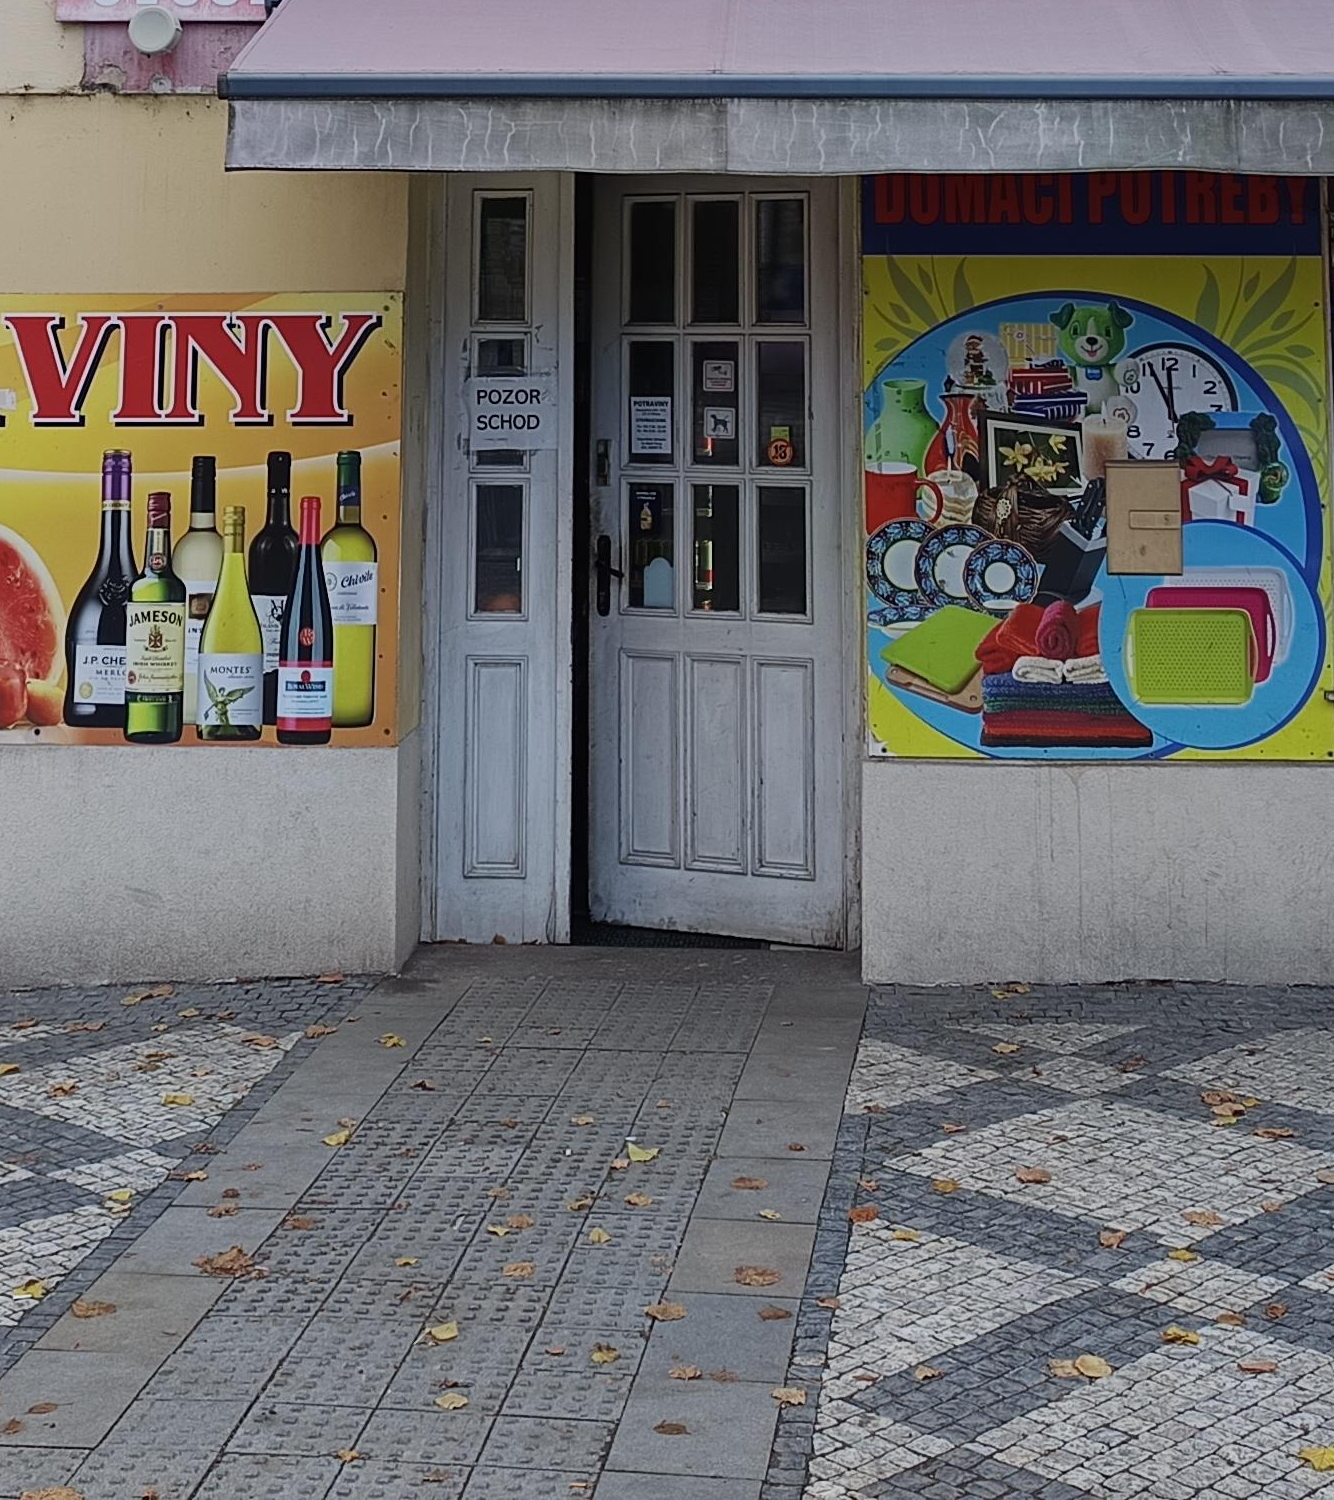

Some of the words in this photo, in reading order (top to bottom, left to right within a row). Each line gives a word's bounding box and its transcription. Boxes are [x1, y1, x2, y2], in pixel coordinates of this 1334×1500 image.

[1161, 357, 1179, 372] 12
[1203, 381, 1217, 395] 2
[476, 389, 542, 407] POZOR
[476, 414, 541, 432] SCHOD
[1127, 425, 1141, 438] 8
[1142, 442, 1155, 457] 7
[129, 609, 183, 628] JAMESON
[210, 666, 249, 675] MONTES
